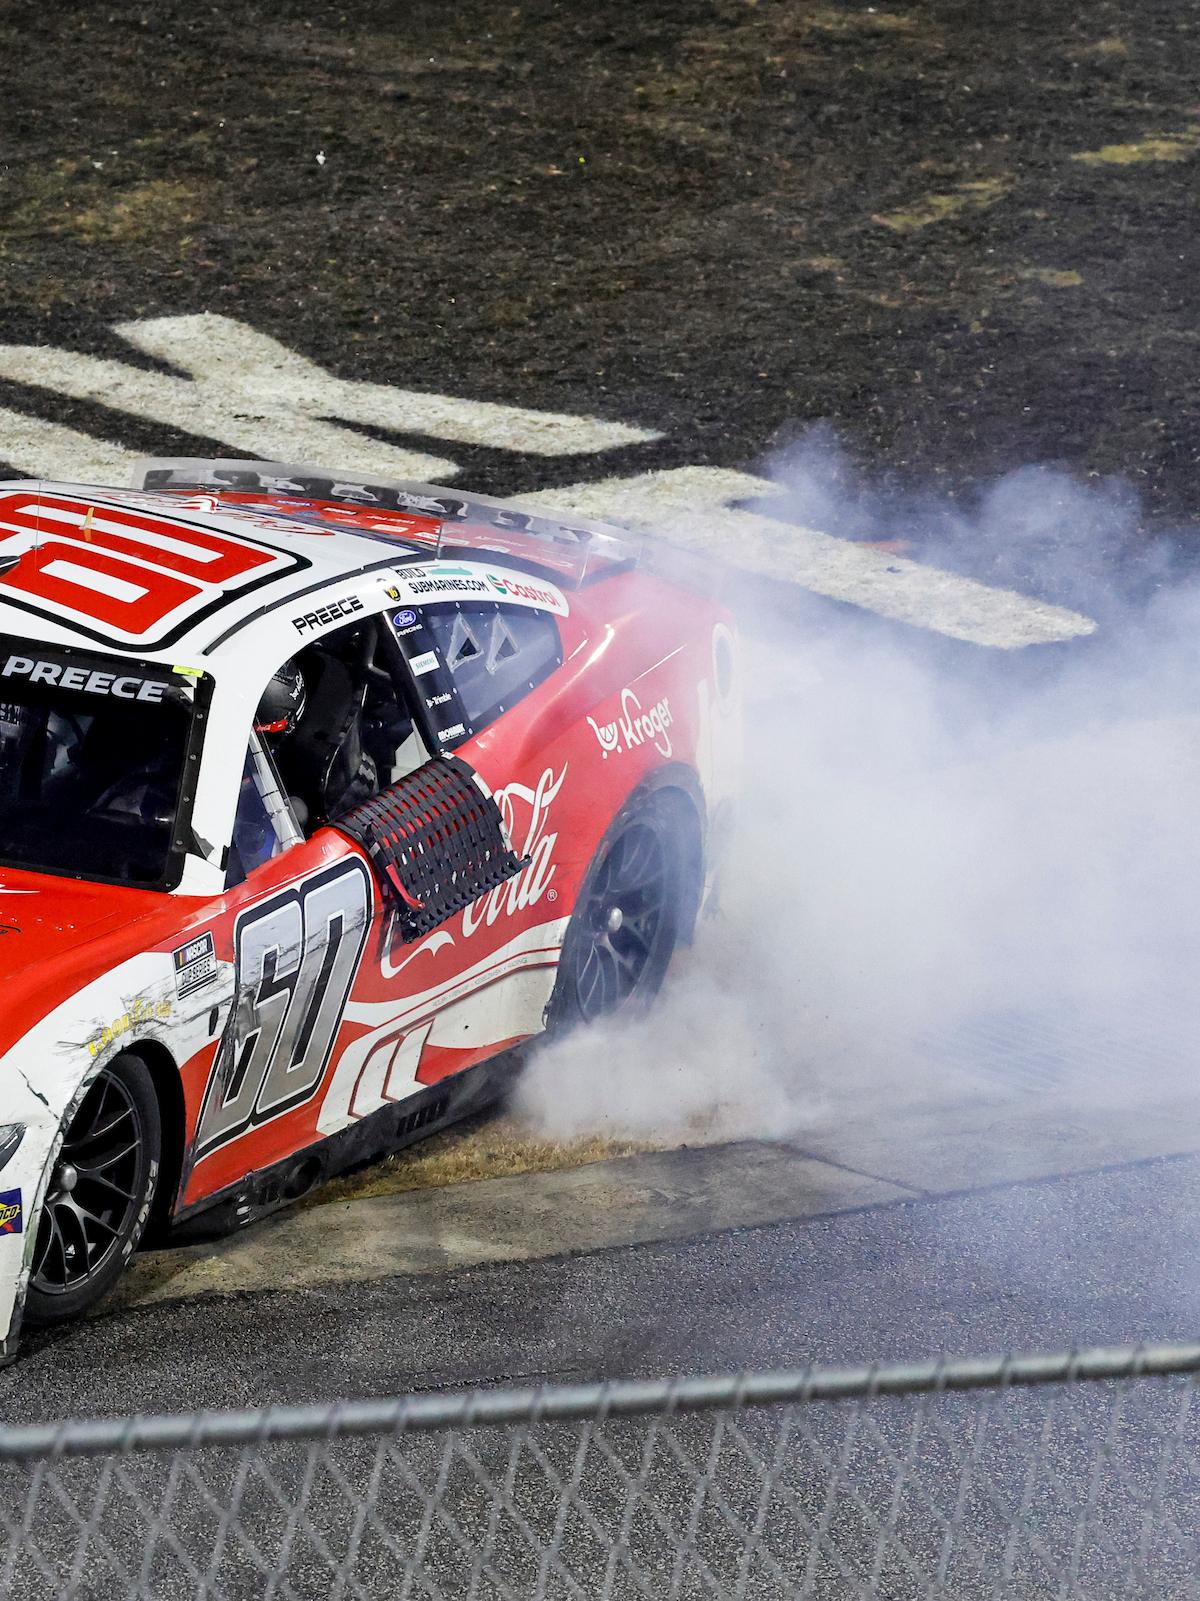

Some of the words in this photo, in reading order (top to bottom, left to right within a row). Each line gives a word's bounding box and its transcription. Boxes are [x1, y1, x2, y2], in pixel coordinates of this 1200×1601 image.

[408, 579, 490, 594] SUBMARINES.COM
[502, 578, 561, 608] Castrol
[292, 595, 364, 636] PREECE
[396, 611, 416, 625] Ford
[1, 655, 169, 703] PREECE
[619, 688, 675, 758] Kroger
[195, 852, 374, 1166] 60
